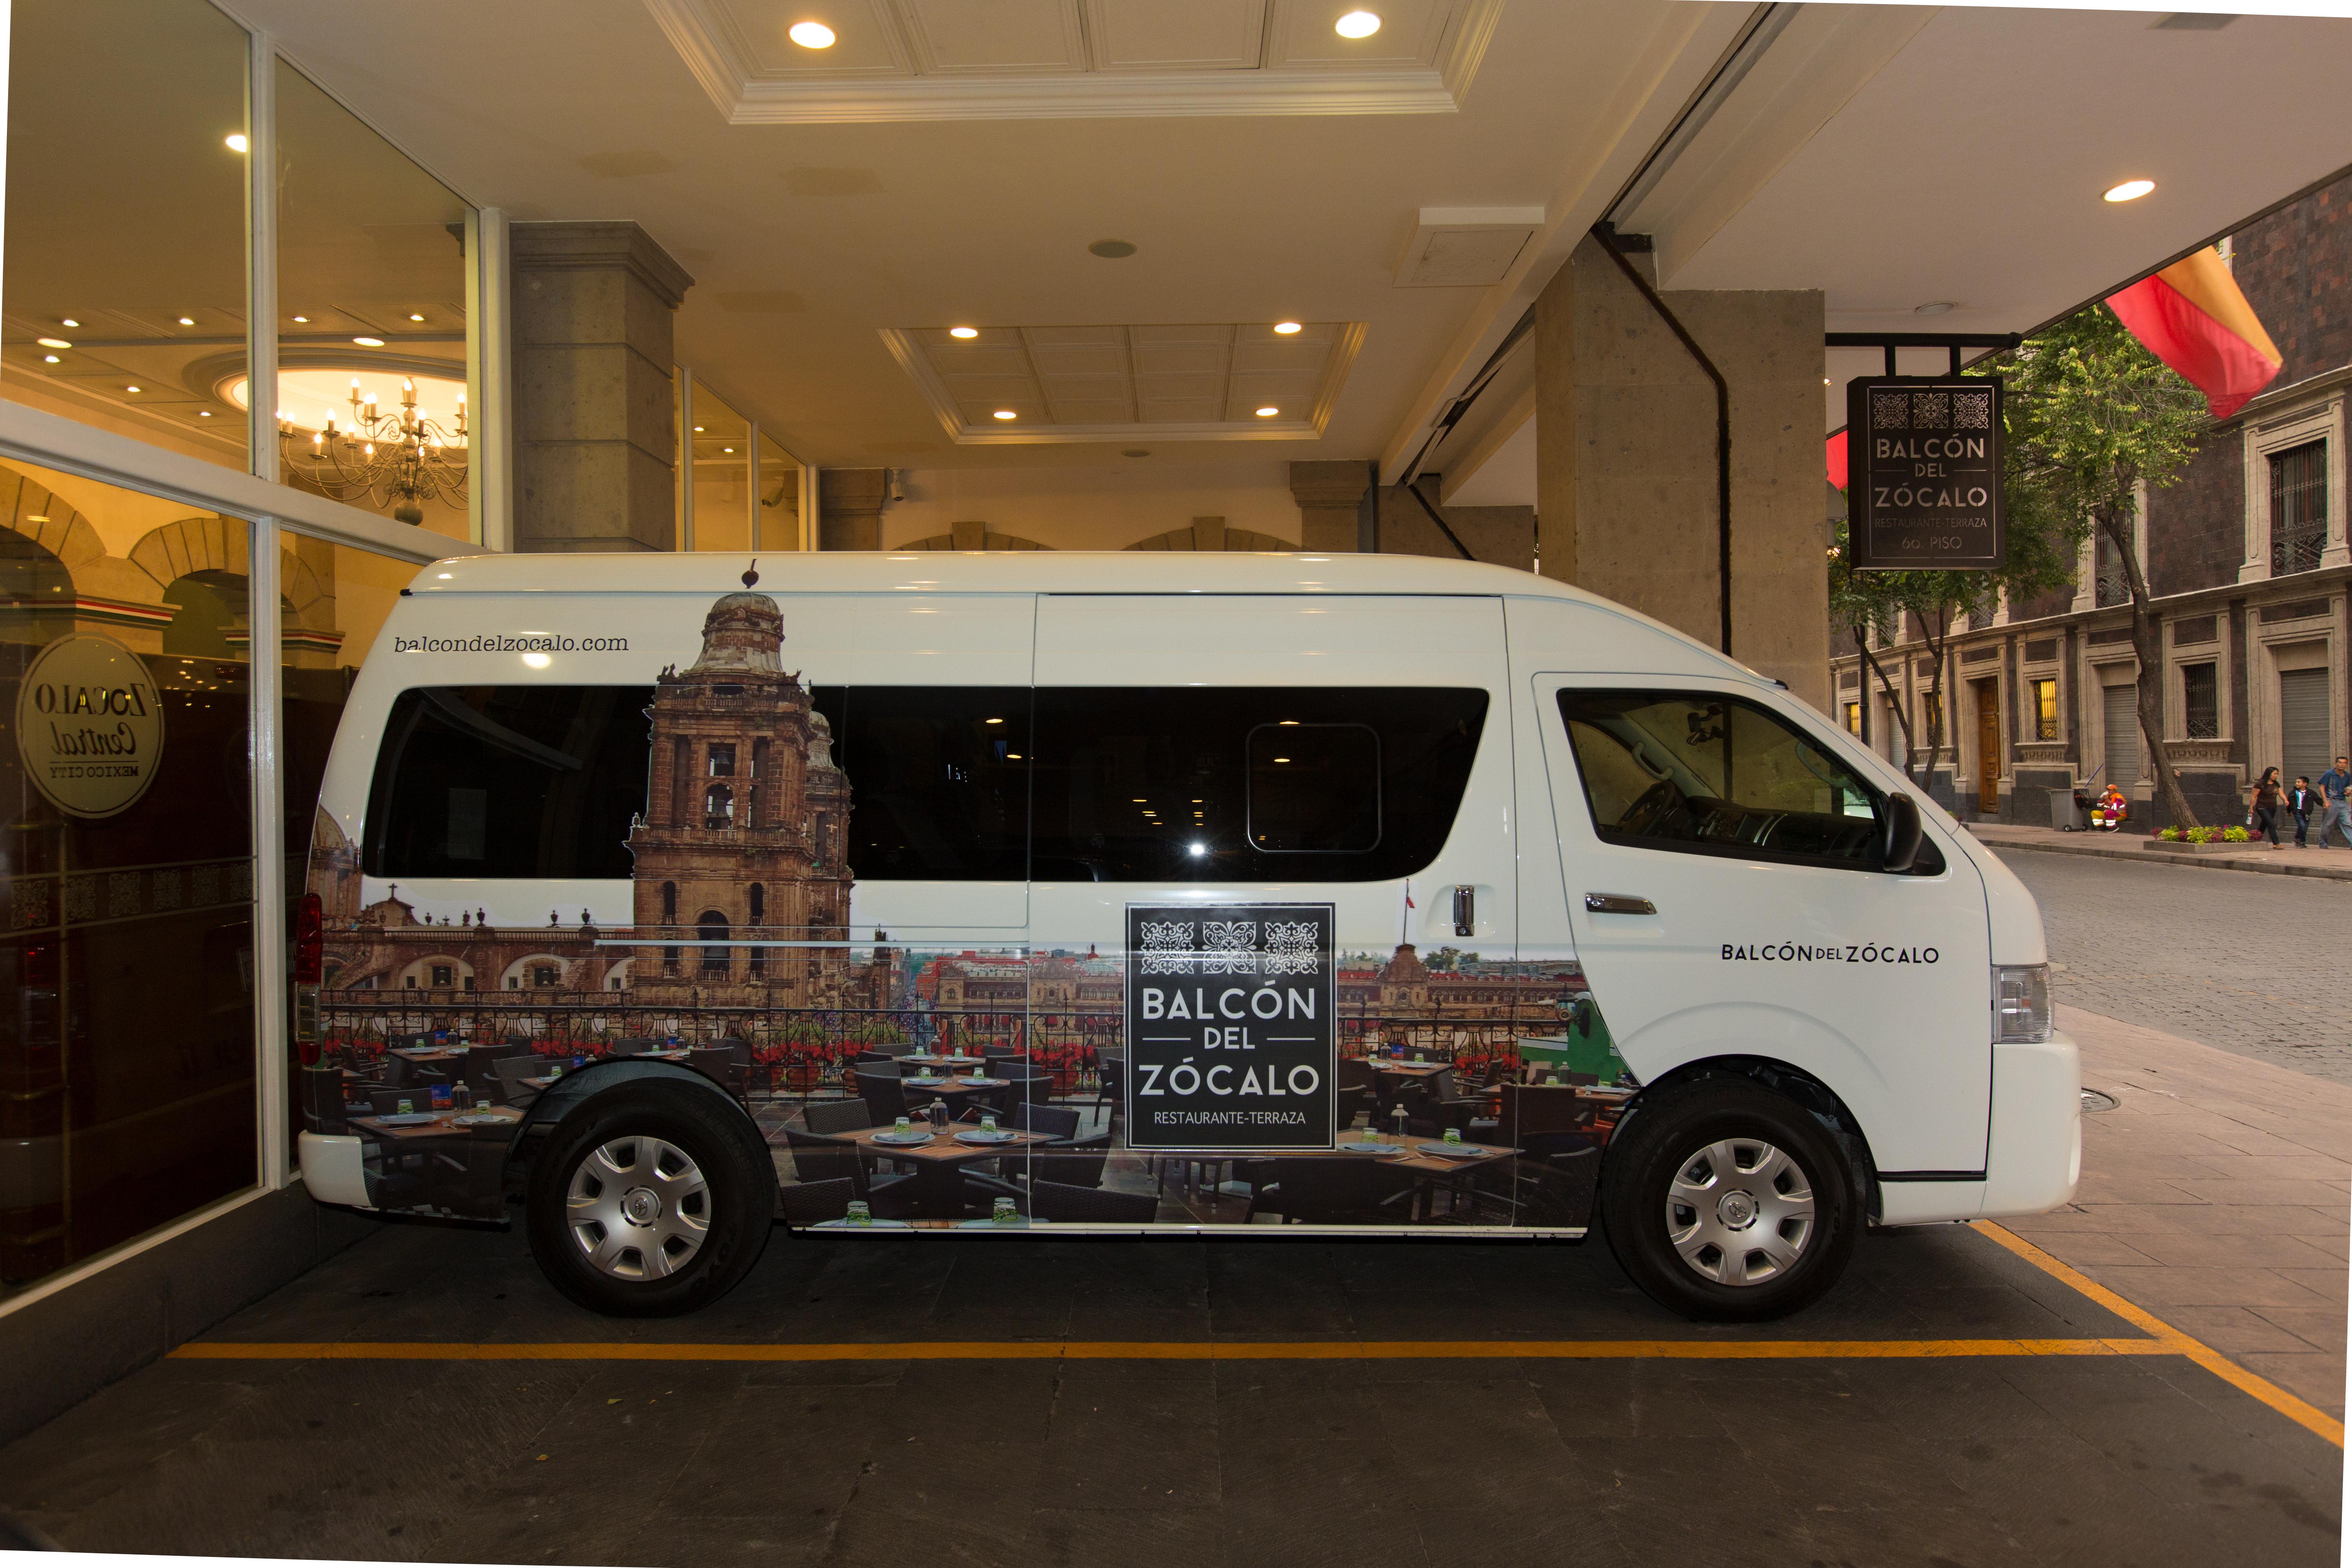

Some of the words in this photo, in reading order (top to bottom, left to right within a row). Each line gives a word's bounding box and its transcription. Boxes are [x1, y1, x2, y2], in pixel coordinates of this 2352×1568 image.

[1876, 433, 1984, 458] BALCÓN
[1915, 463, 1947, 477] DEL
[1875, 482, 1987, 507] ZÓCALO
[1875, 518, 1987, 528] RESTAURANTE-TERRAZA
[1930, 537, 1962, 549] PISO
[394, 635, 629, 653] balcondelzocalo.com
[1722, 941, 1812, 962] BALCÓN
[1816, 948, 1843, 960] DEL
[1846, 942, 1939, 964] ZÓCALO
[1143, 980, 1314, 1020] BALCÓN
[1204, 1027, 1255, 1049] DEL
[1138, 1056, 1319, 1096] ZÓCALO
[1154, 1111, 1306, 1125] RESTAURANTE-TERRAZA
